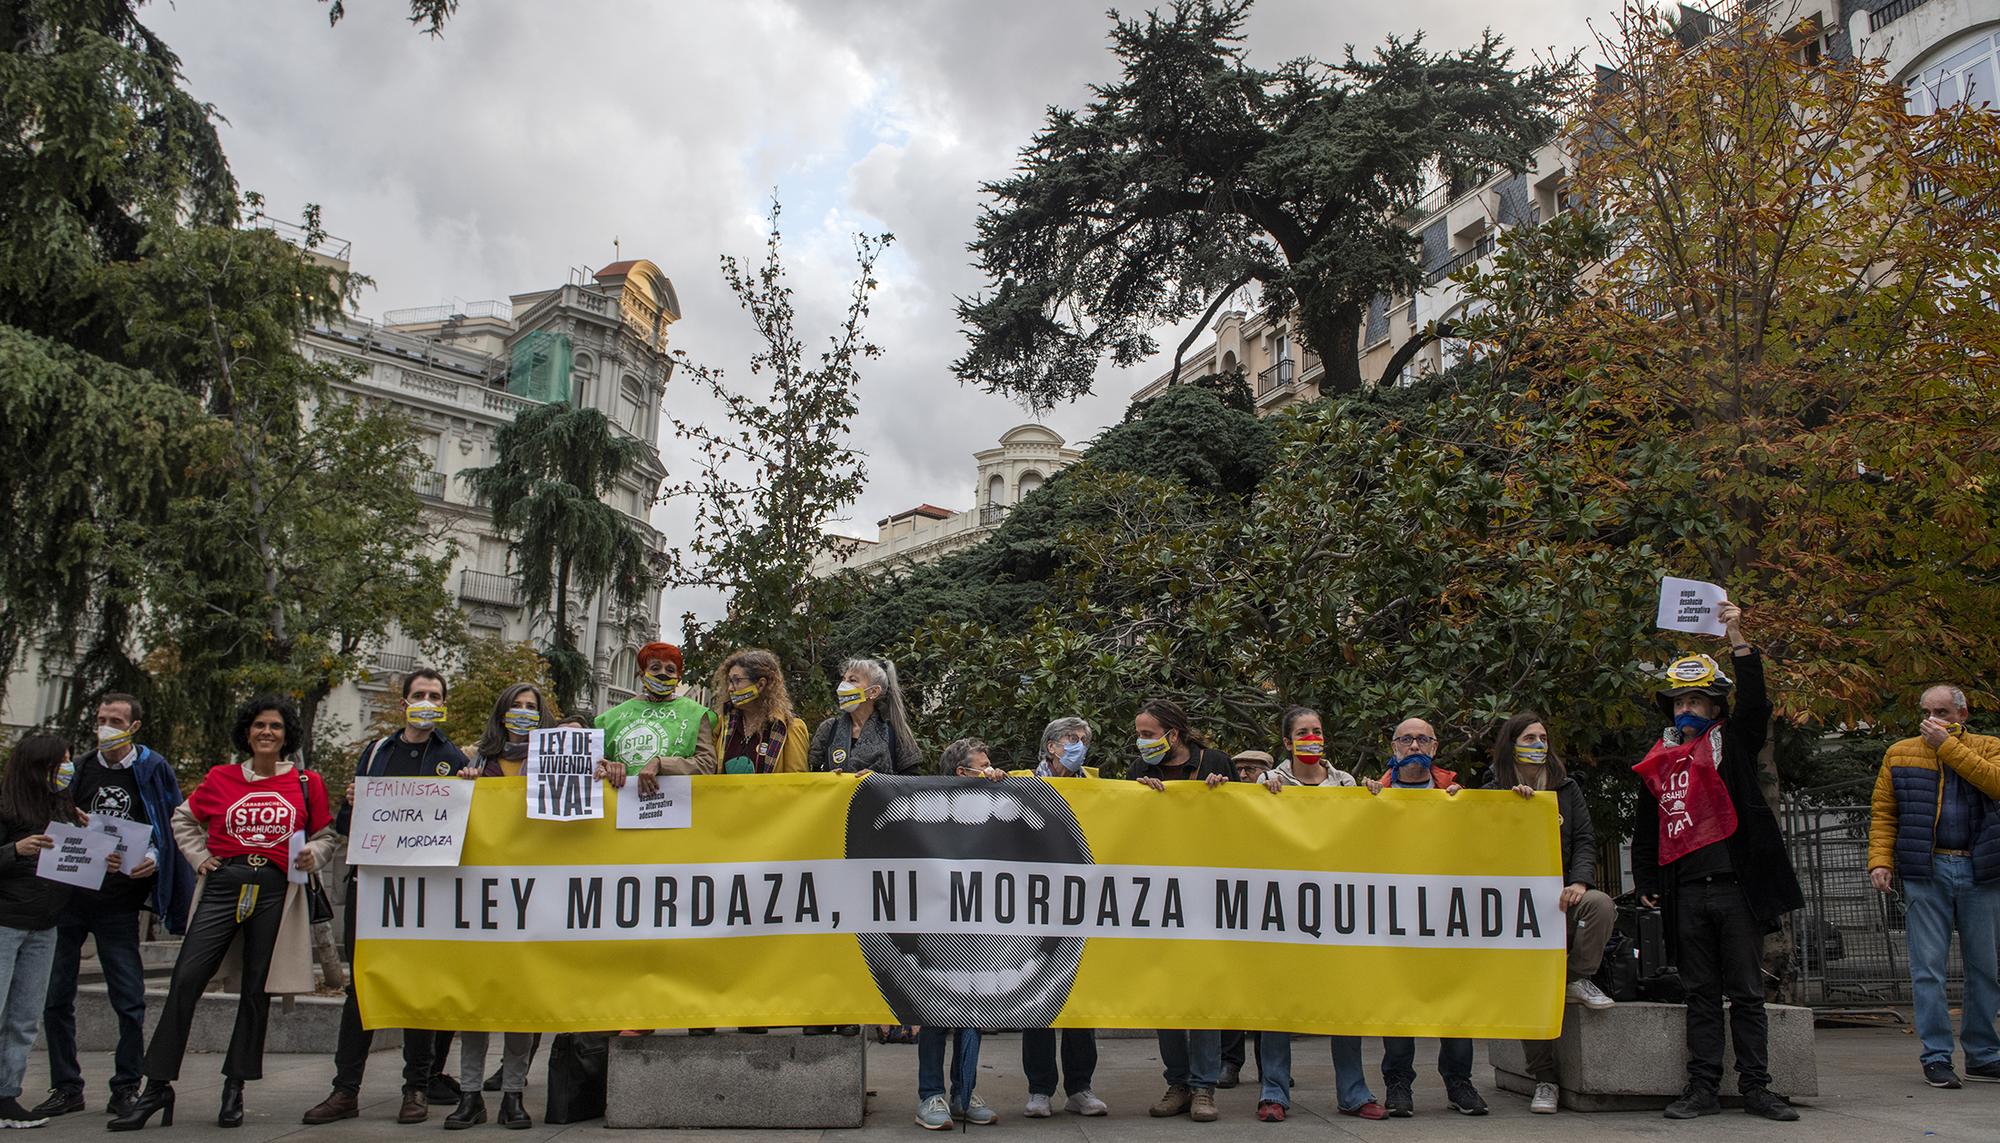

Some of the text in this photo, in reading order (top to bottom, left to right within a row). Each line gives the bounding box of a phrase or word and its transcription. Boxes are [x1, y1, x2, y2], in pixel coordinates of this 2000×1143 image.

[641, 707, 677, 719] CASA
[539, 731, 592, 755] LEY DE
[624, 734, 653, 750] STOP
[539, 755, 593, 774] VIVIENDA
[538, 774, 592, 816] ¡YA!
[235, 807, 289, 826] STOP
[372, 808, 447, 822] CONTRA LA
[236, 824, 287, 834] DESAHUCIOS
[362, 833, 452, 853] LEY MORDAZA
[382, 871, 1542, 939] NI LEY MORDAZA, NI MORDAZA MAQUILLADA
